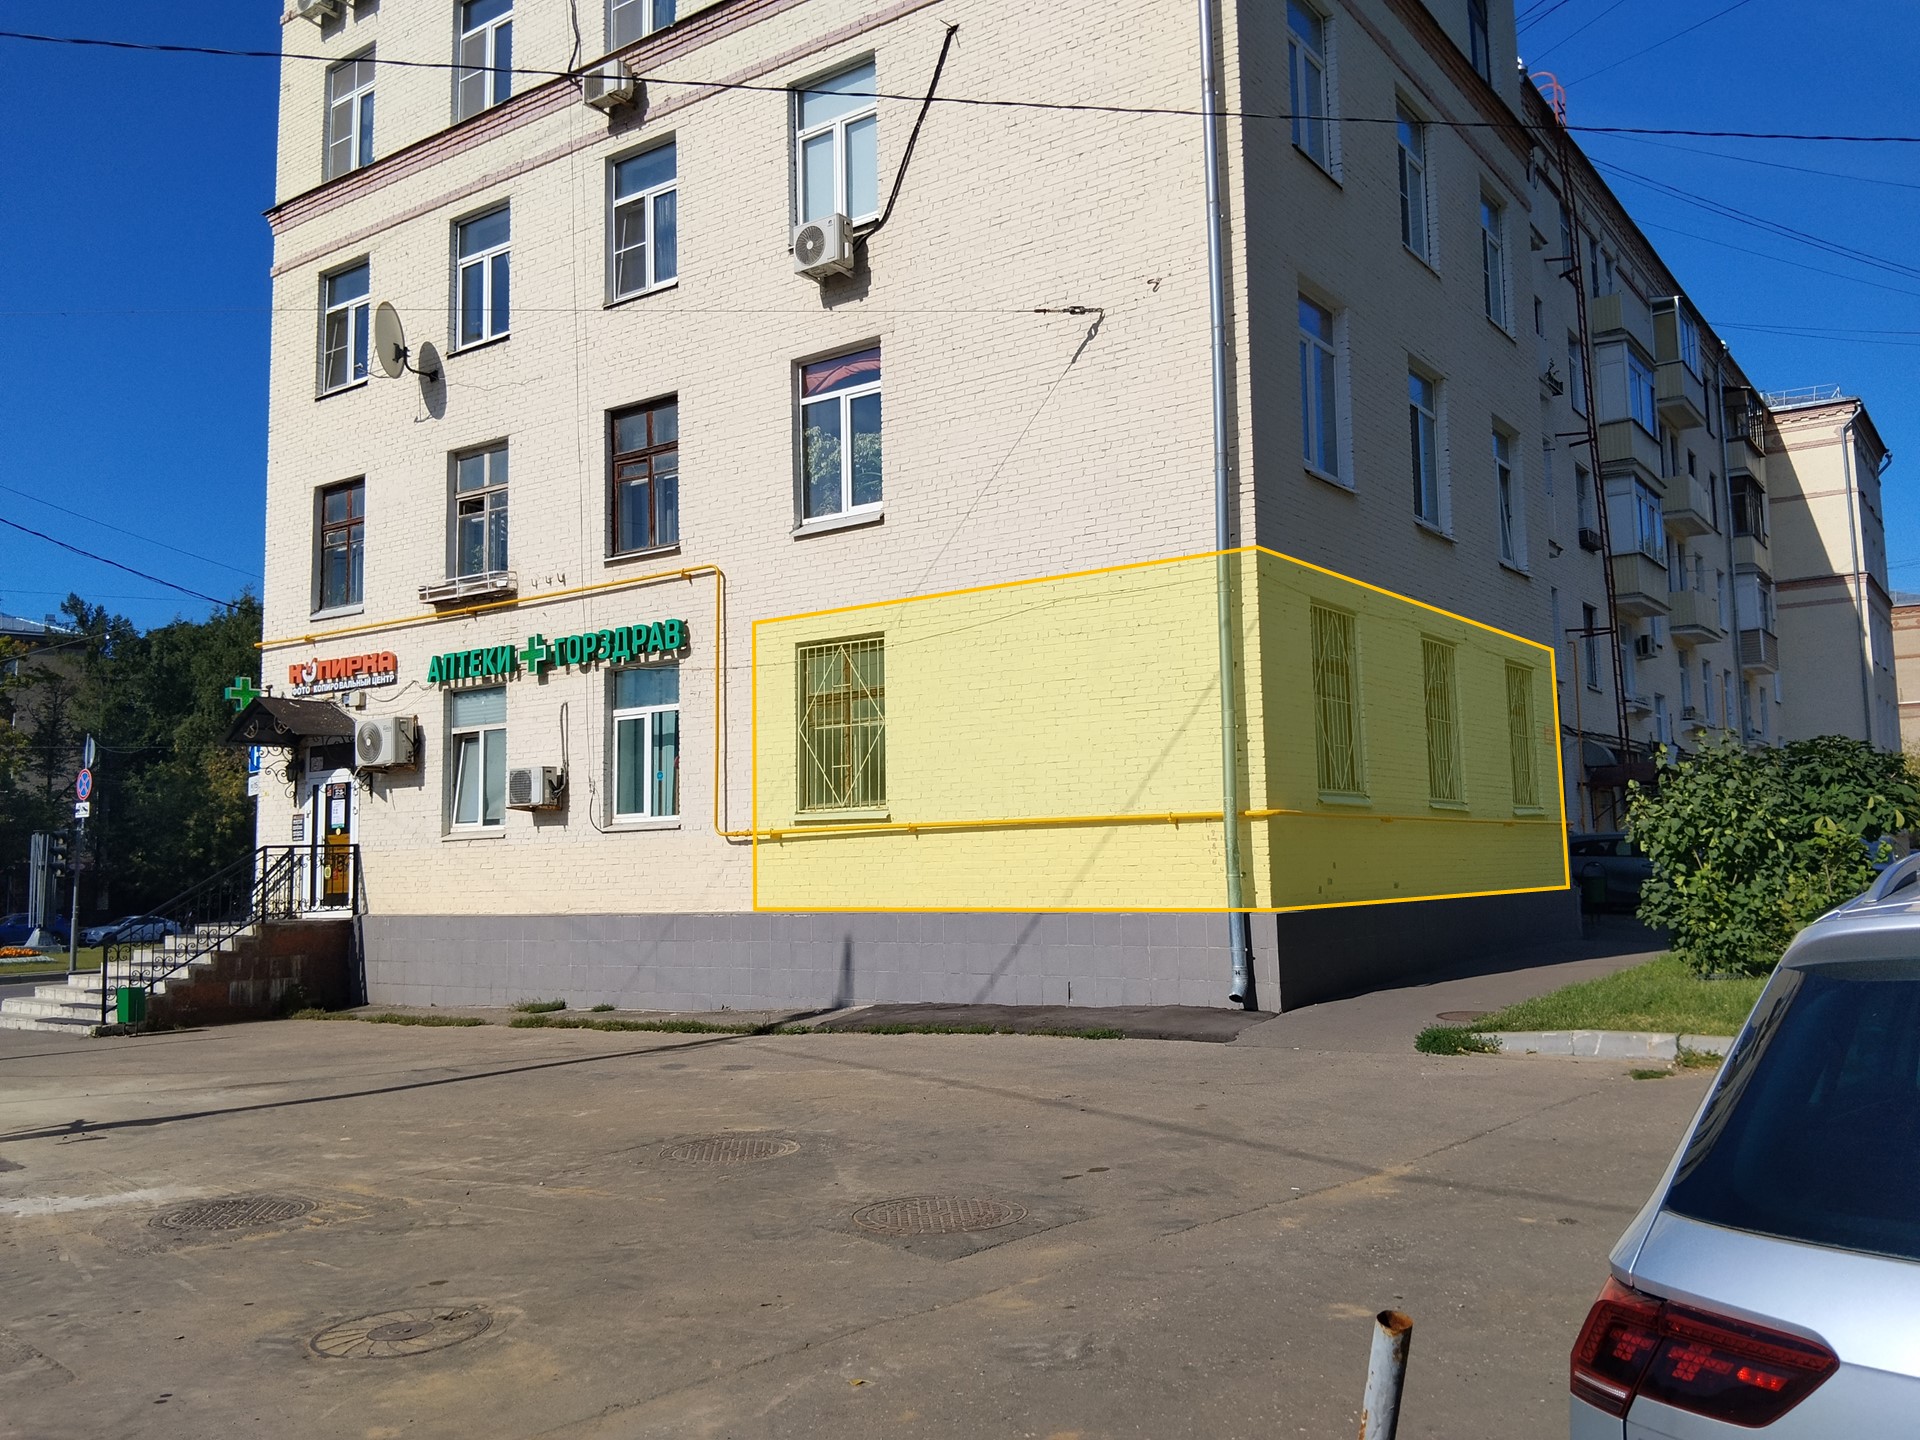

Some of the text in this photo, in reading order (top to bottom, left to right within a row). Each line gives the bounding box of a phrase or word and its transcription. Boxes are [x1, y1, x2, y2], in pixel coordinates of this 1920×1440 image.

[288, 650, 398, 685] КОПИРКА
[427, 618, 685, 682] АПТЕКИ ГОРЗДРАВ
[292, 686, 311, 696] ФОТО
[372, 674, 395, 686] ЦЕНТР
